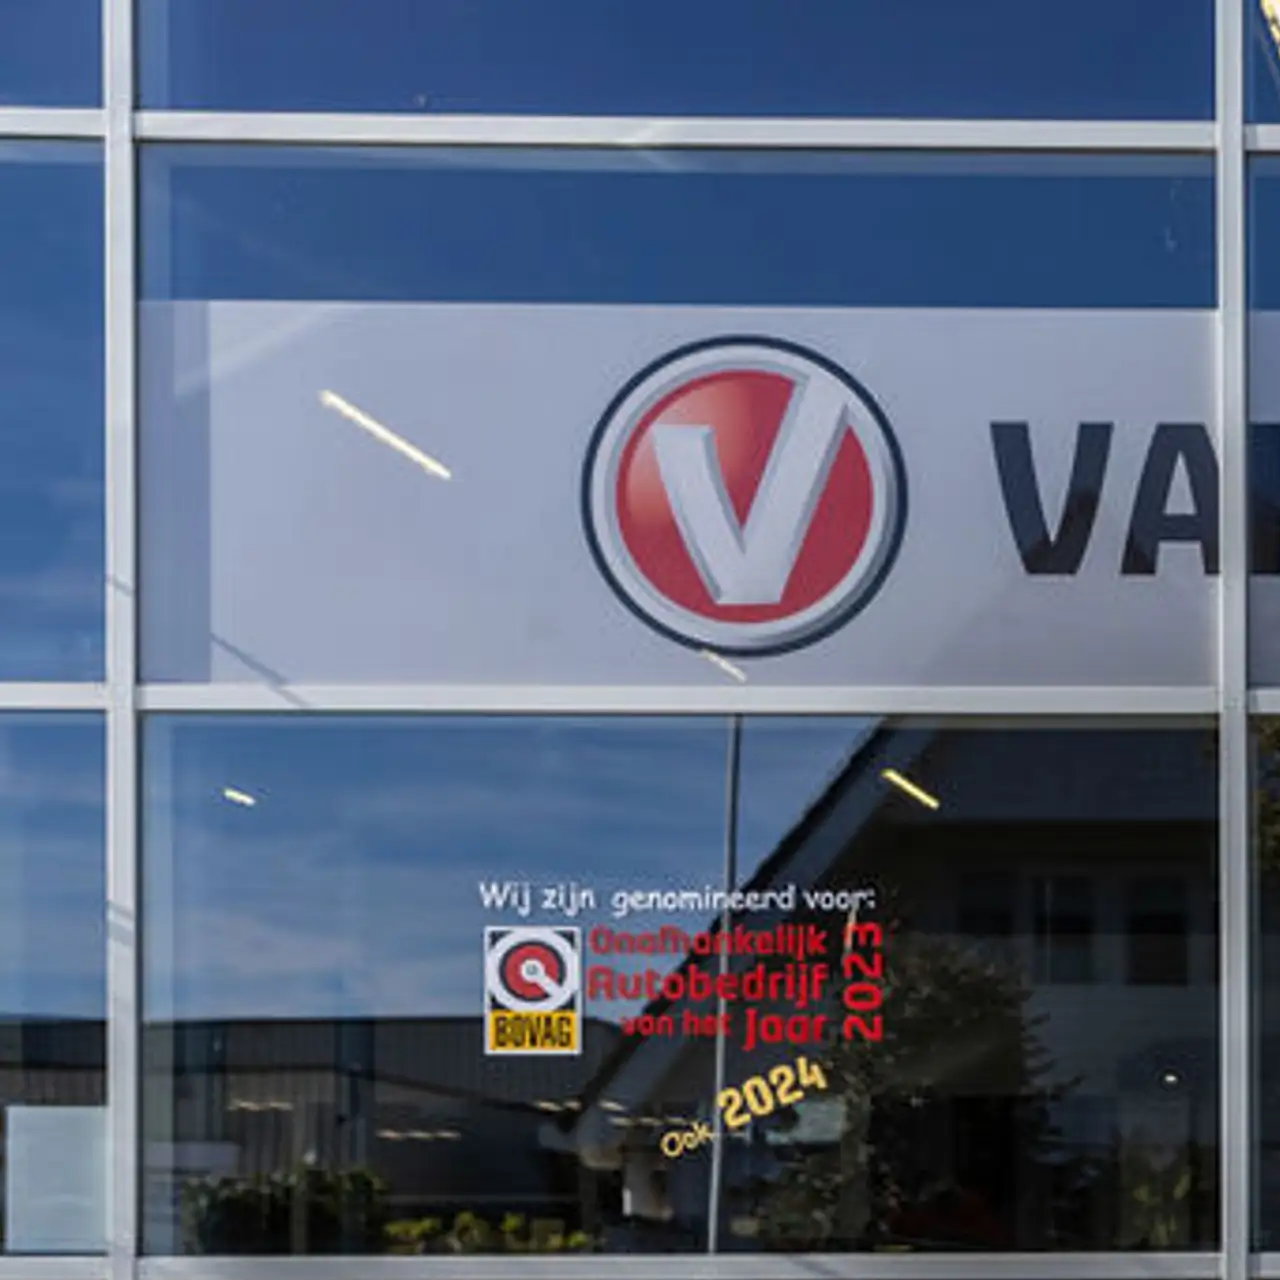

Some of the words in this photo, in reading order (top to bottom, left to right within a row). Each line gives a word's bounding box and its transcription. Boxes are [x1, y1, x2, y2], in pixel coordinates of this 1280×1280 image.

[479, 881, 530, 917] Wij
[541, 882, 597, 917] zijn
[611, 884, 797, 918] genomineerd
[586, 963, 828, 1010] Autobedrijf
[843, 920, 884, 1043] 2023
[495, 1014, 572, 1048] BOVAG
[620, 1012, 675, 1037] van
[682, 1007, 732, 1037] het
[742, 1006, 828, 1050] Jaar
[660, 1120, 715, 1158] Ook
[716, 1055, 828, 1129] 2024
